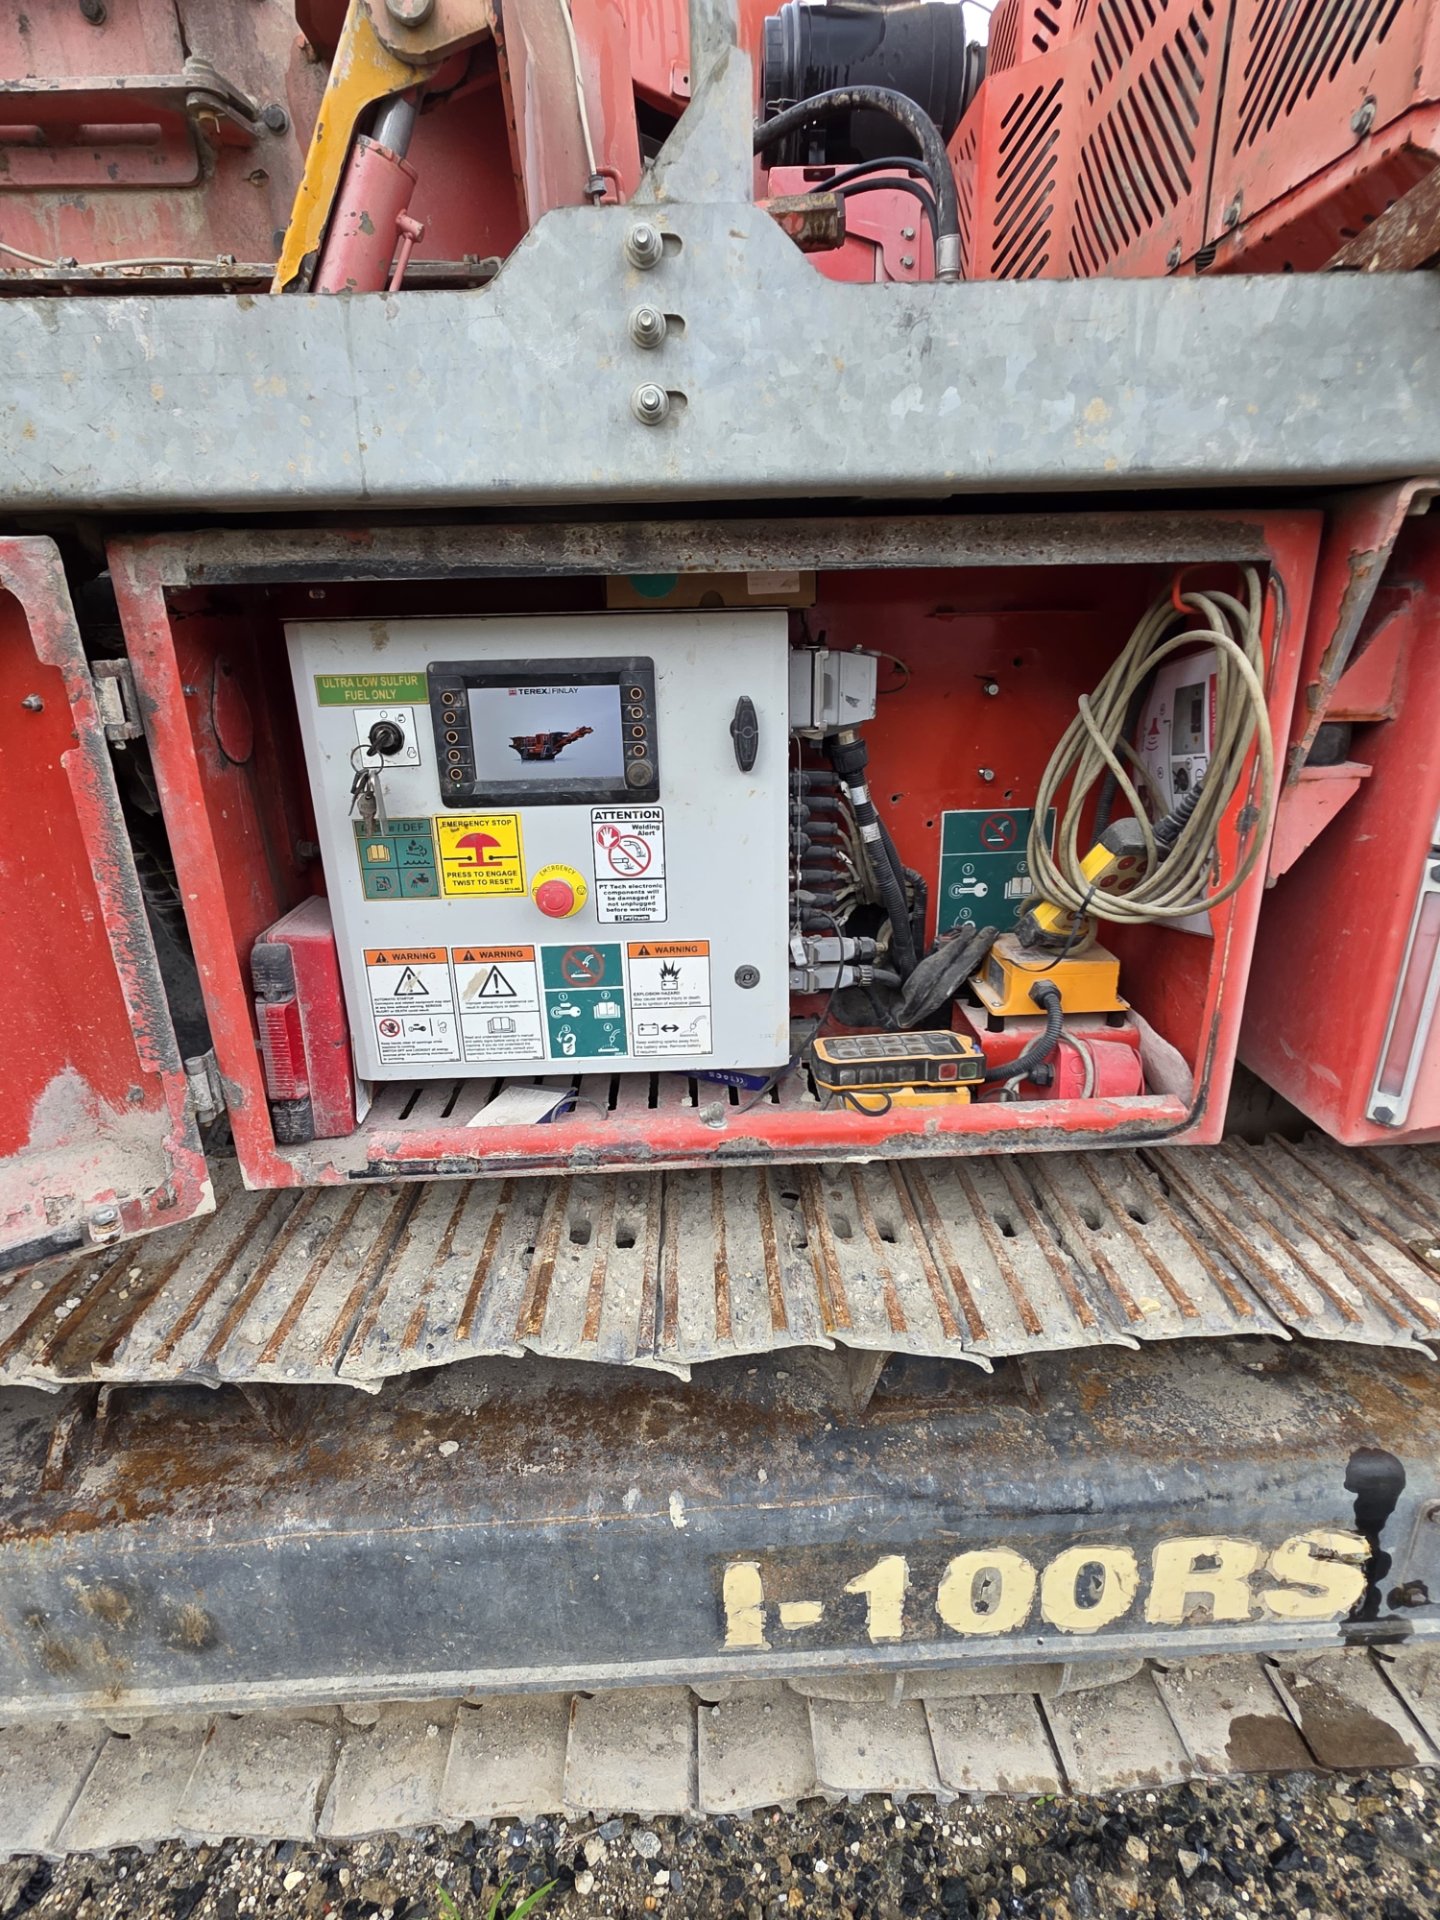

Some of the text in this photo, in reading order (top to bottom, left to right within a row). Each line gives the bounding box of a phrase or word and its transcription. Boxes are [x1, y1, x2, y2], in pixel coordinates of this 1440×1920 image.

[322, 676, 418, 688] ULTRA LOW SULFUR
[344, 689, 396, 700] FUEL ONLY
[594, 811, 660, 820] ATTENTION
[403, 822, 424, 832] DEF
[540, 865, 576, 876] EMERGENCY
[479, 950, 523, 958] WARNING
[654, 945, 698, 954] WARNING
